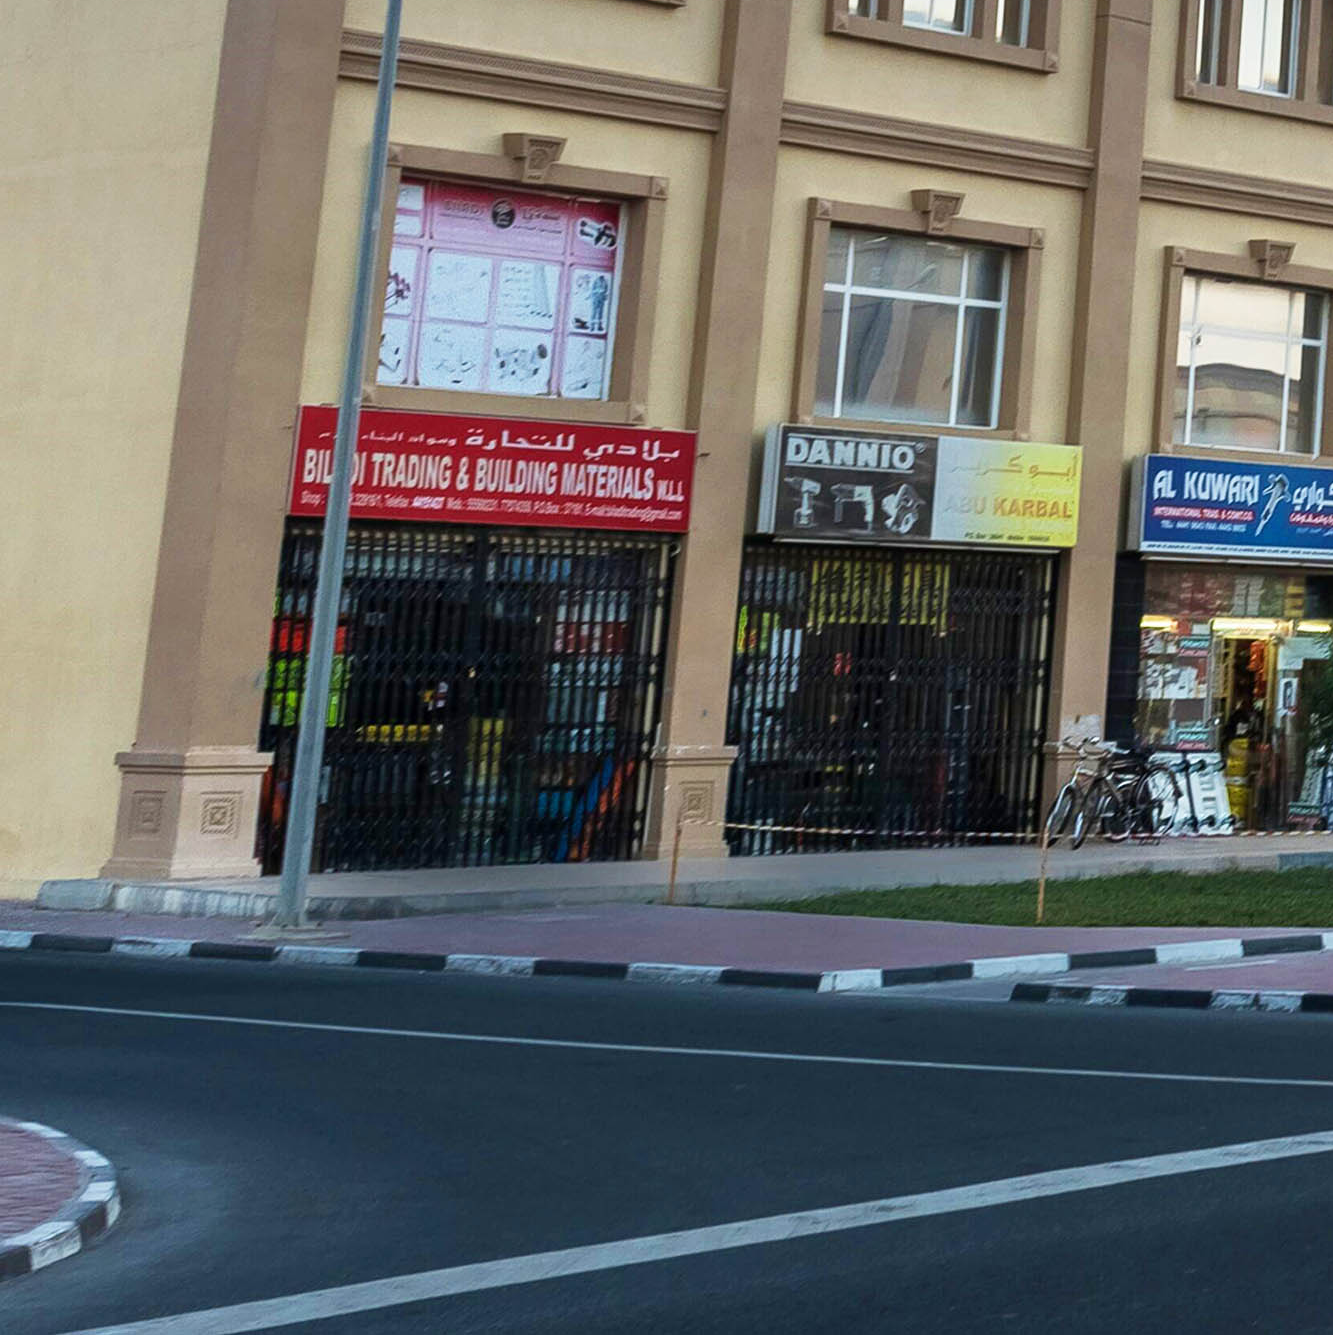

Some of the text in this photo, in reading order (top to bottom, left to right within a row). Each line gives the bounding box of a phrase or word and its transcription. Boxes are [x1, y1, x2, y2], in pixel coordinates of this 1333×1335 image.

[583, 439, 681, 463] بلادي
[786, 436, 915, 470] DANNIO
[302, 448, 367, 487] BILDI
[371, 452, 453, 491] TRADING
[455, 456, 470, 492] &
[473, 457, 558, 496] BUILDING
[560, 462, 655, 501] MATERIALS
[1152, 469, 1260, 506] AL KUWARI
